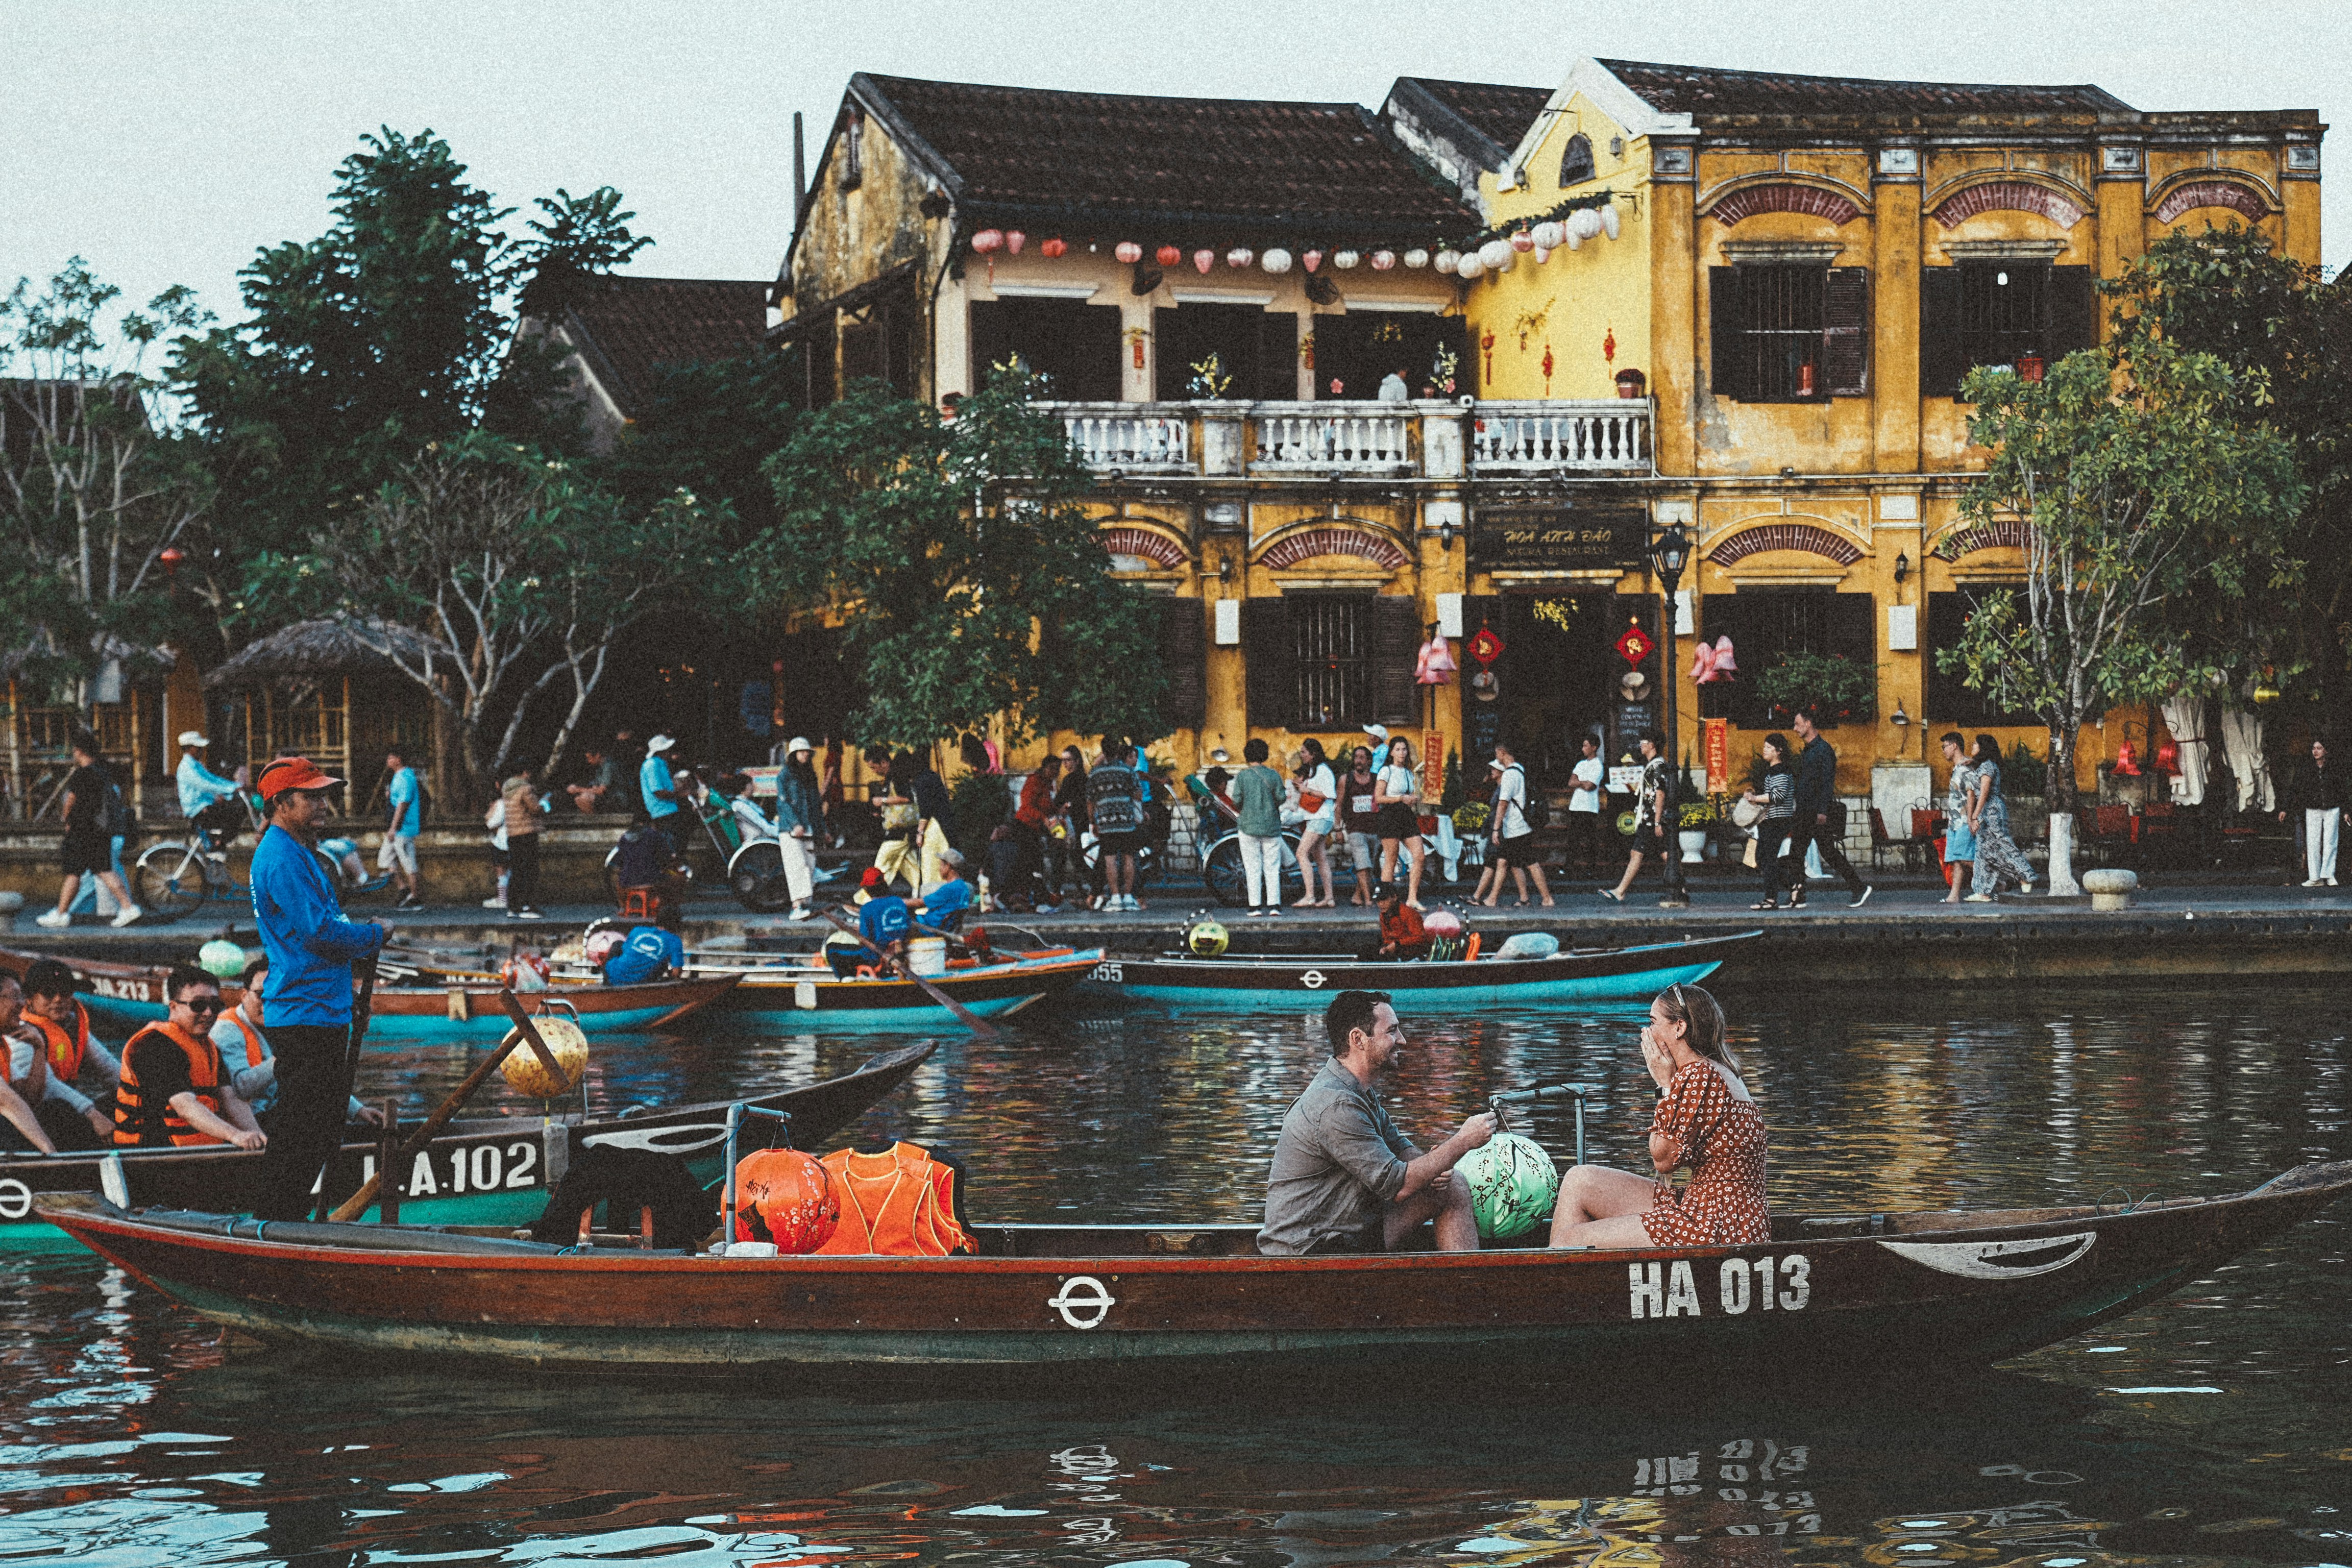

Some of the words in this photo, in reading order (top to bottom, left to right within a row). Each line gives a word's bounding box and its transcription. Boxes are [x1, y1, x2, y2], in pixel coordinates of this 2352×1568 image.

[1548, 546, 1610, 556] RESTAURANT
[1629, 1260, 1701, 1319] HA
[1720, 1254, 1811, 1315] 013
